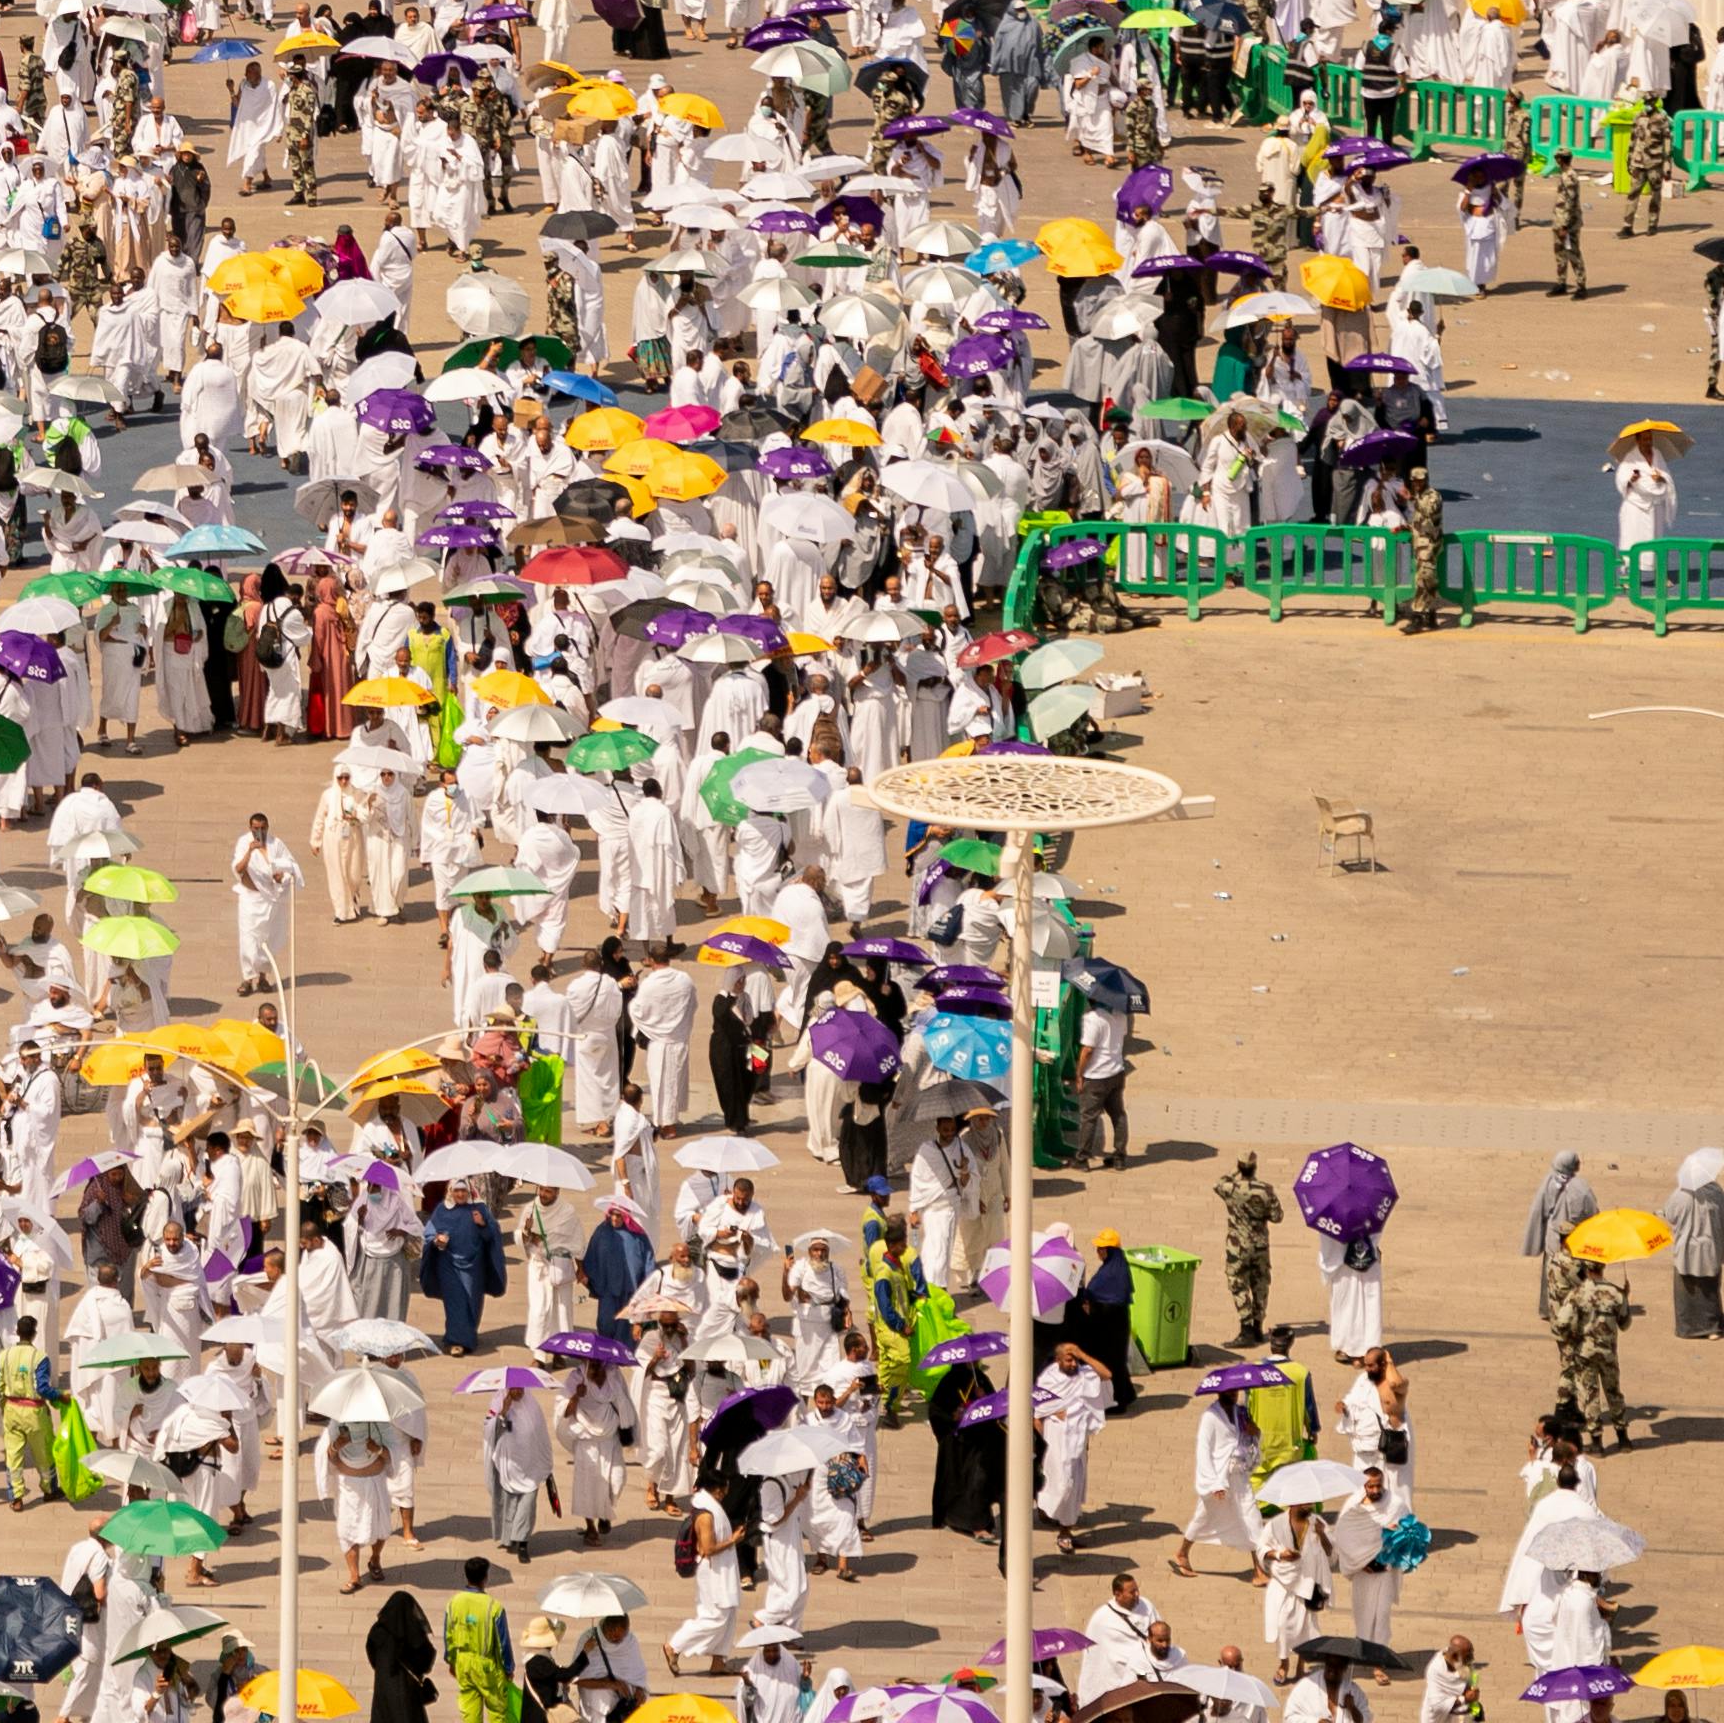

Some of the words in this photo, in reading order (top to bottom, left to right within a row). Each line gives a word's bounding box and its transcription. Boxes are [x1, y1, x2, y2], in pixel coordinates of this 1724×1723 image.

[974, 115, 994, 130] stc
[390, 418, 412, 432] stc
[789, 462, 812, 476] stc
[27, 664, 48, 680] stc
[719, 939, 744, 952] stc
[863, 942, 889, 954] stc
[821, 1049, 847, 1072] stc
[879, 1055, 896, 1074] stc
[1350, 1146, 1376, 1163] stc
[1300, 1160, 1319, 1184] stc
[1376, 1196, 1392, 1221] stc
[1317, 1216, 1342, 1235] stc
[1577, 1243, 1606, 1259] DHL
[565, 1339, 593, 1353] stc
[1260, 1369, 1283, 1384] stc
[1587, 1679, 1615, 1694] stc
[1671, 1673, 1699, 1685] DHL
[1528, 1683, 1549, 1699] stc
